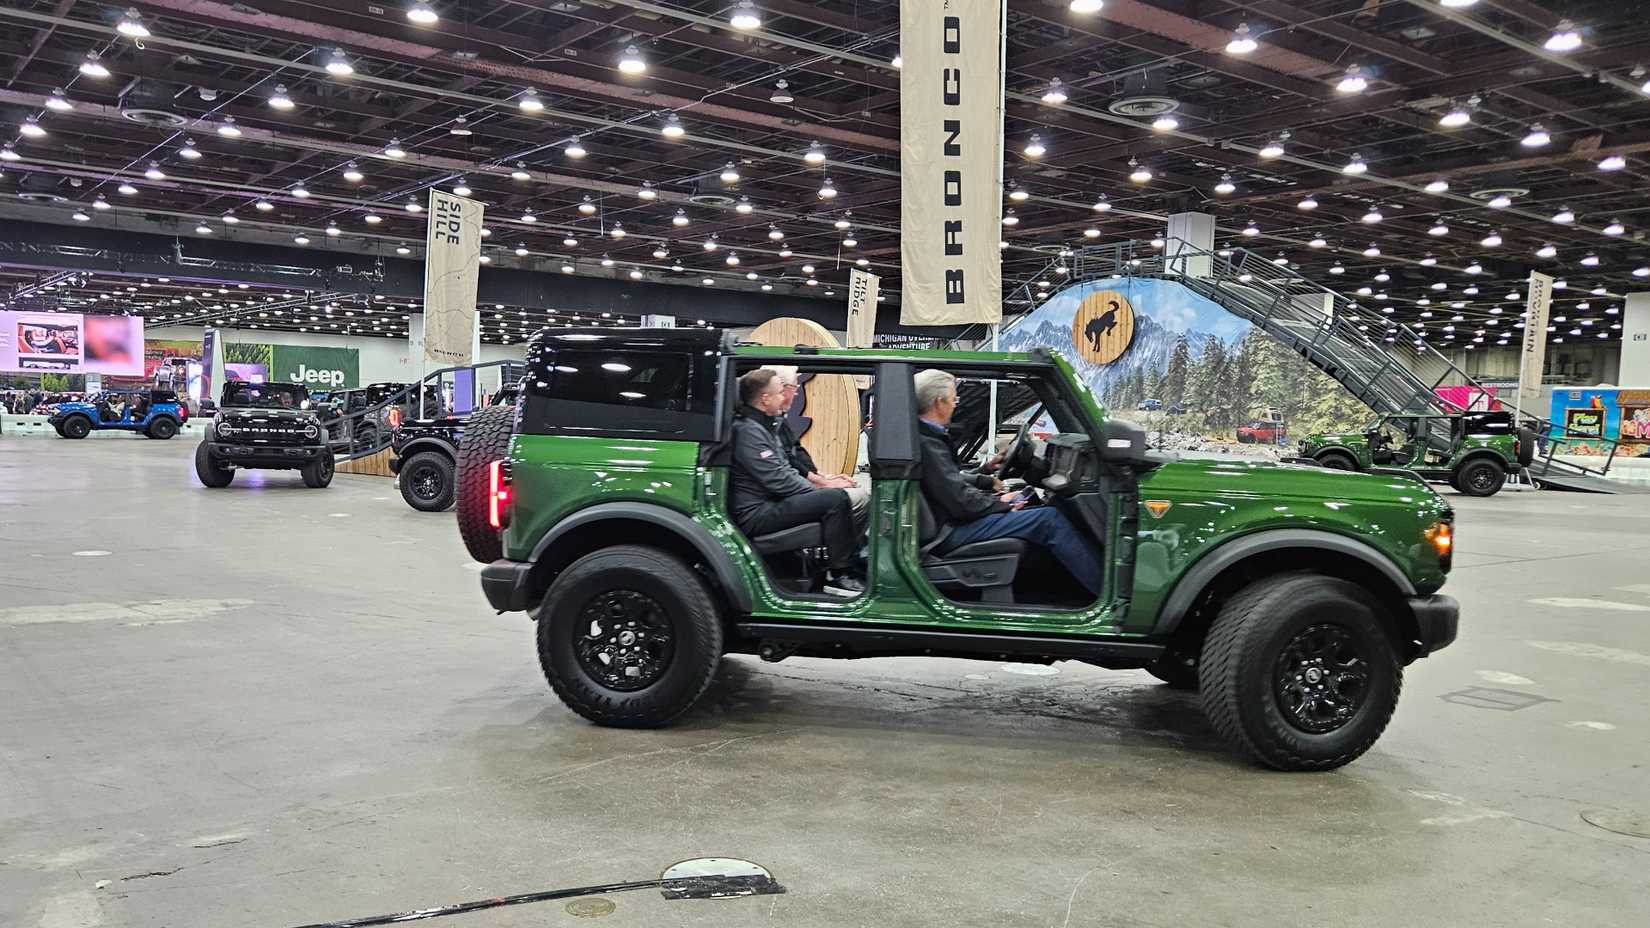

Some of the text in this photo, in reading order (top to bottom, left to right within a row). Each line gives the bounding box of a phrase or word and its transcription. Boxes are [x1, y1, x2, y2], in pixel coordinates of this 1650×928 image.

[944, 16, 964, 304] BRONCO
[435, 199, 448, 239] HILL
[447, 202, 461, 245] SIDE
[851, 276, 861, 317] RIDGE
[289, 364, 345, 387] Jeep
